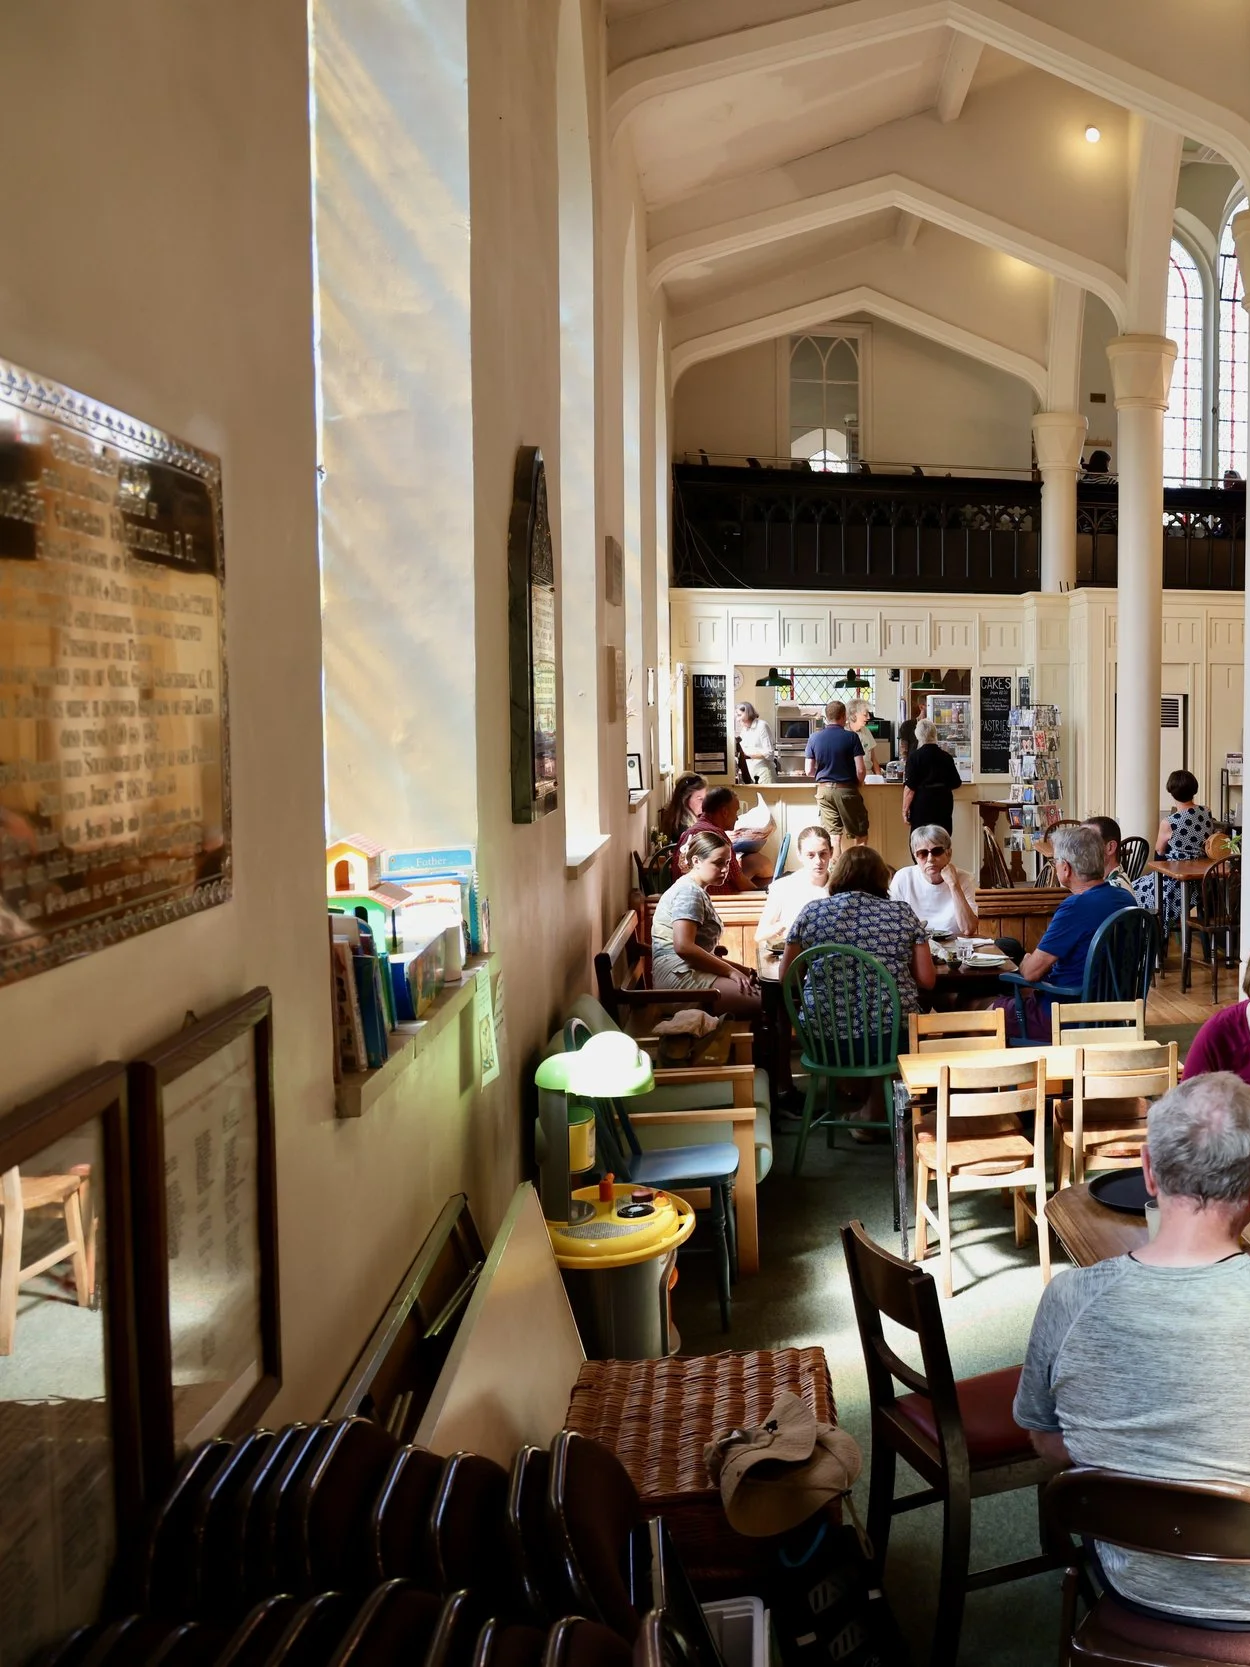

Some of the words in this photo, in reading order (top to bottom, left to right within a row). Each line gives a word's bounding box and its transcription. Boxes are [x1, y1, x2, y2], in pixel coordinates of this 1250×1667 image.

[694, 676, 725, 688] LUNCH
[981, 678, 1012, 690] CAKES
[416, 855, 447, 867] Father
